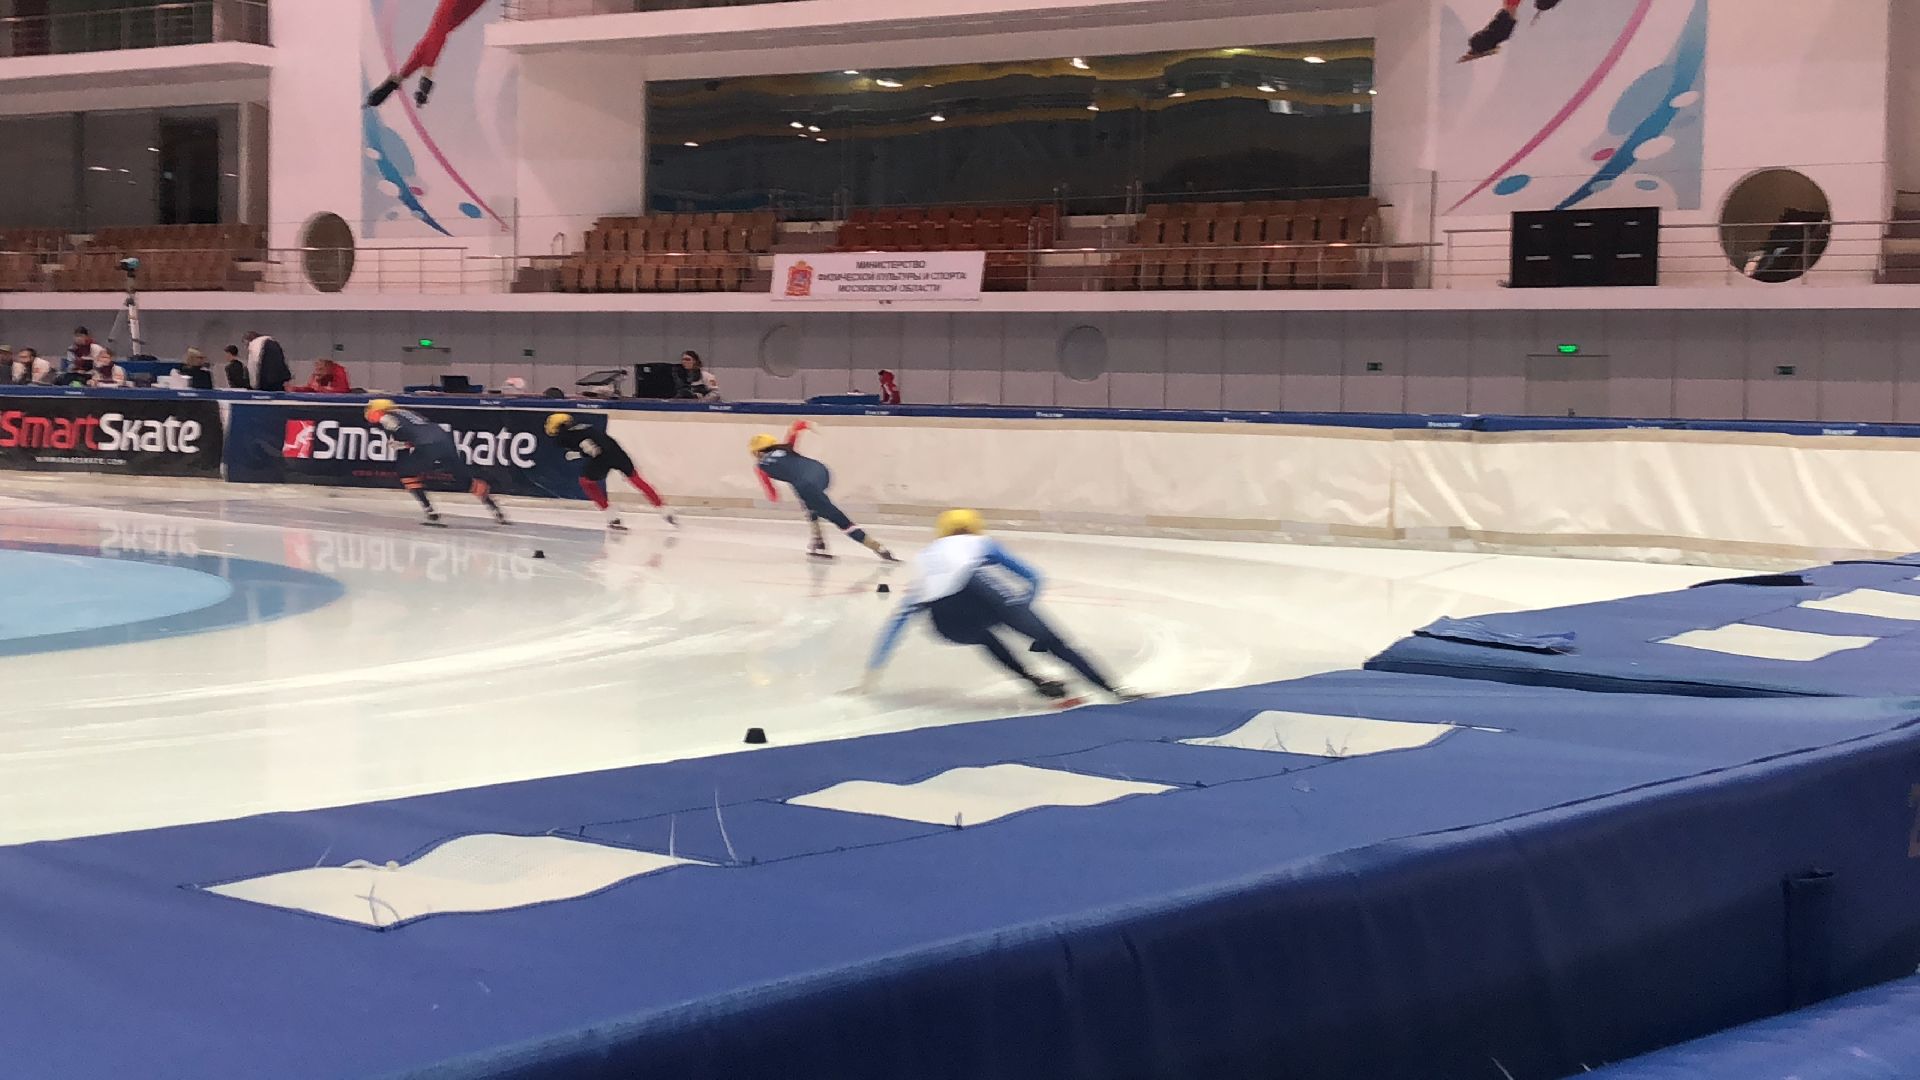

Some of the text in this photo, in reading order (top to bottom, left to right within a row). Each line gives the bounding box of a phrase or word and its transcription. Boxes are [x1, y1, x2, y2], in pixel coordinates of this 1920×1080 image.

[856, 260, 926, 269] МИНИСТЕРСТВО
[931, 271, 968, 280] СПОРТА
[838, 283, 942, 292] МОСКОВСКОЙ ОБЛАСТИ
